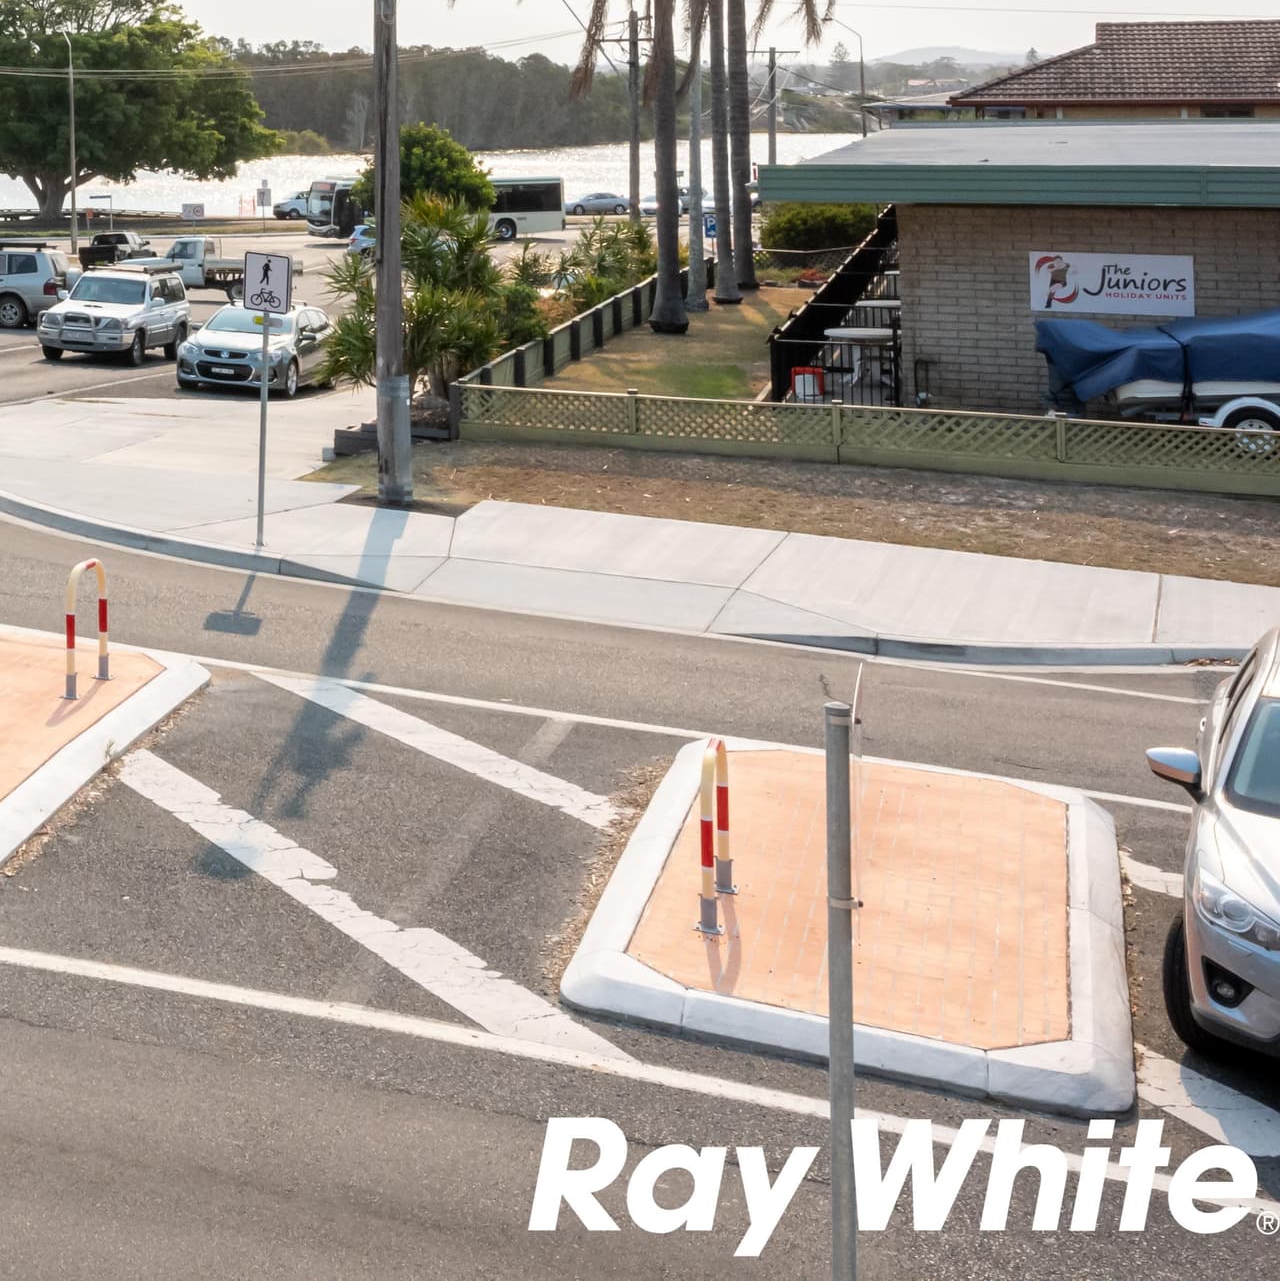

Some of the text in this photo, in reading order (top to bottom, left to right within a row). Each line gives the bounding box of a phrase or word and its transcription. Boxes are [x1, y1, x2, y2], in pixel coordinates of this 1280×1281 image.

[707, 218, 716, 228] P
[1104, 264, 1132, 276] The
[1082, 266, 1187, 296] Juniors
[1105, 292, 1188, 301] HOLIDAY UNITS
